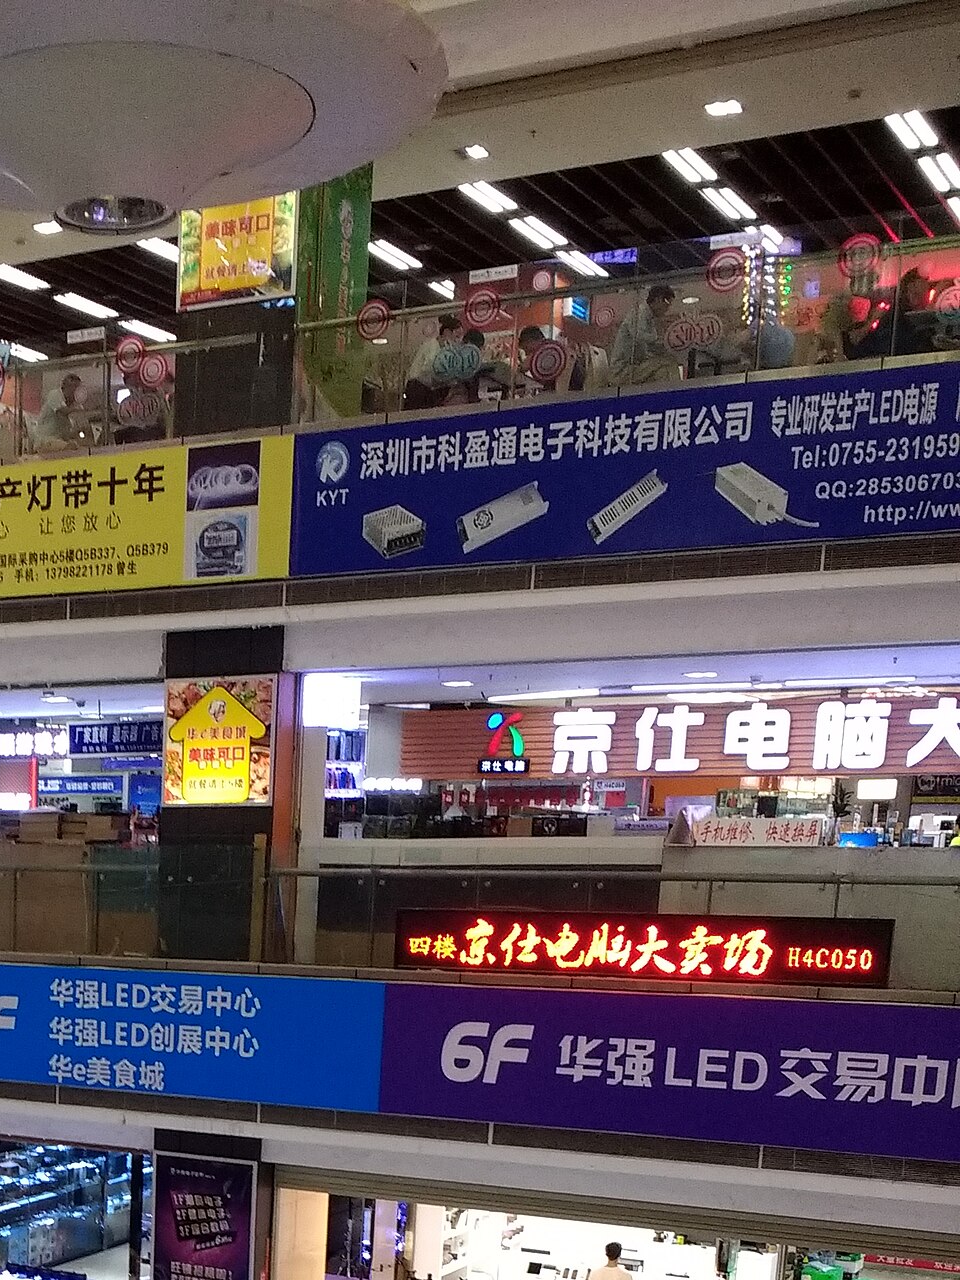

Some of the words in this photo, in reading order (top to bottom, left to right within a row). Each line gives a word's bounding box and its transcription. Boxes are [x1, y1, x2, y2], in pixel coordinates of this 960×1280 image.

[359, 402, 753, 482] 深圳市科盈通电子科技有限公司
[771, 382, 940, 438] 专业研发生产LED电源
[316, 489, 350, 507] KYT
[39, 511, 121, 536] 让您放心
[189, 747, 245, 761] 美味可口
[481, 760, 525, 772] 京仕电脑
[409, 935, 455, 960] 四楼
[460, 918, 773, 977] 京仕电脑大卖场
[788, 946, 873, 971] H4C050
[48, 978, 261, 1019] 华强LED交易中心
[48, 1017, 260, 1058] 华强LED创展中心
[48, 1054, 166, 1092] 华e美食城
[440, 1021, 535, 1085] 6F
[555, 1035, 960, 1107] 华强LED交易中
